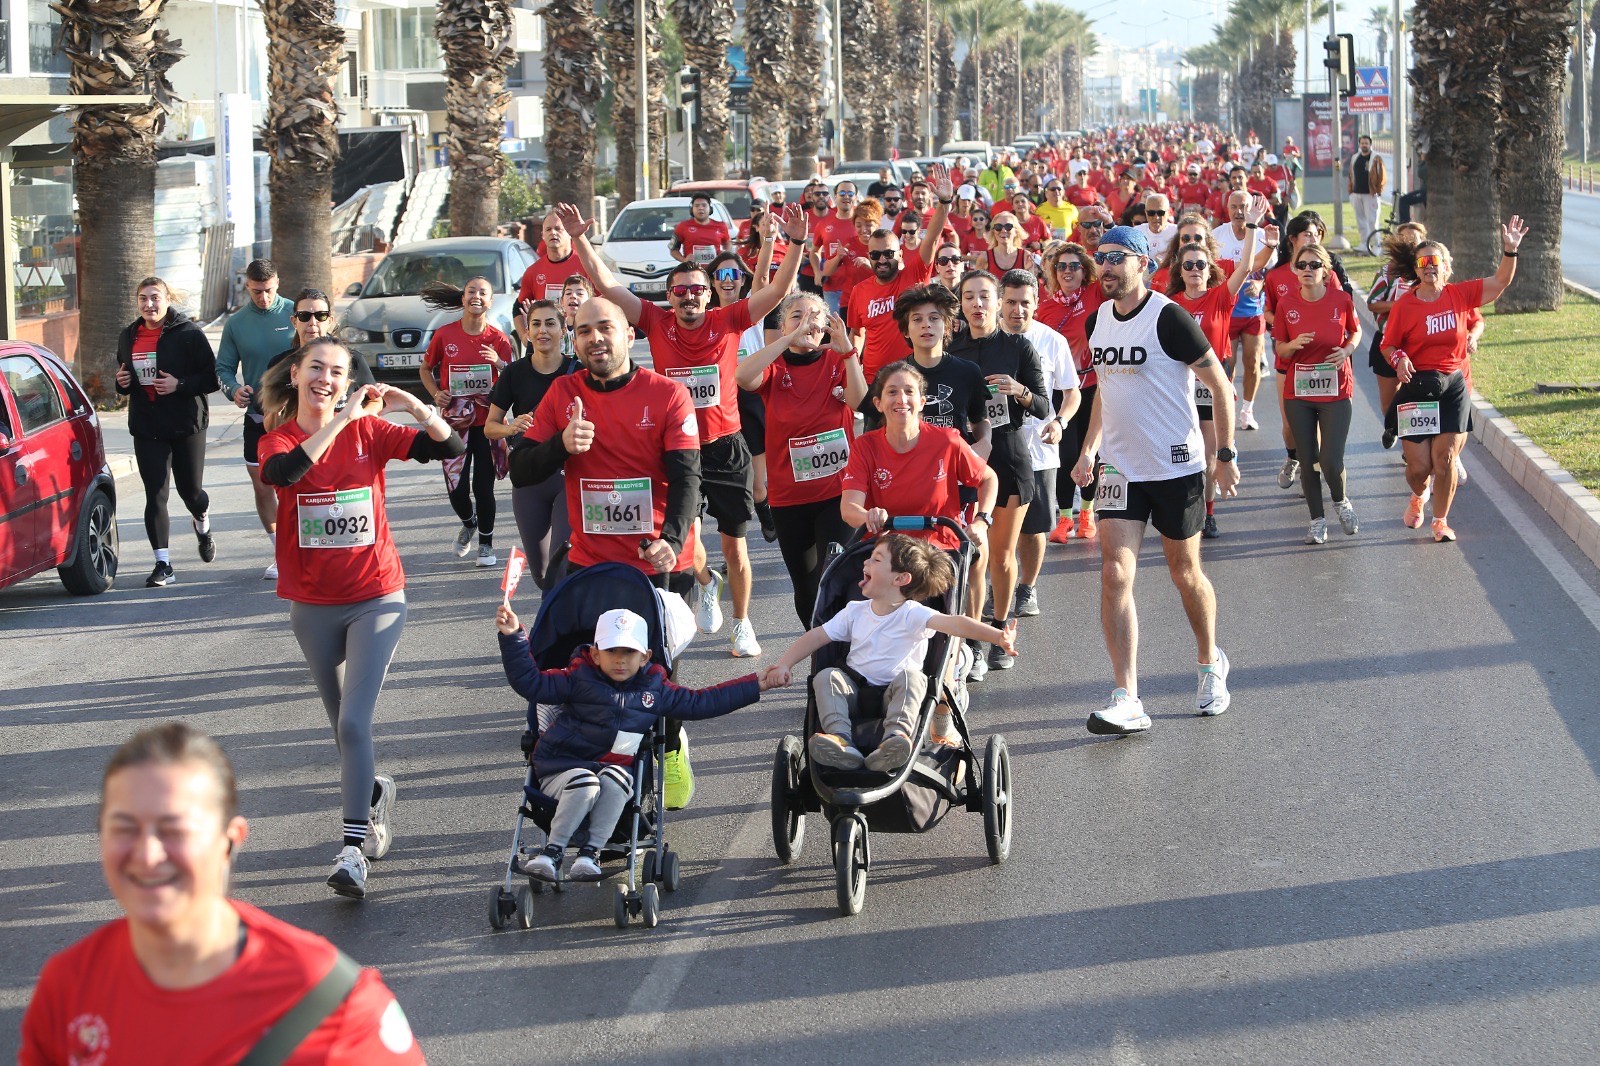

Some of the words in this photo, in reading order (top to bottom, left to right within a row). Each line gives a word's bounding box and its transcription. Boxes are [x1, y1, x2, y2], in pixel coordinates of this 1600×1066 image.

[384, 356, 394, 366] 35
[402, 356, 412, 365] RT
[1092, 346, 1148, 366] BOLD
[451, 379, 488, 390] 351025
[1296, 378, 1332, 390] 350117
[924, 416, 954, 424] DER
[794, 450, 848, 472] 350204
[1096, 485, 1121, 500] 310
[584, 504, 641, 522] 351661
[302, 516, 368, 536] 350932
